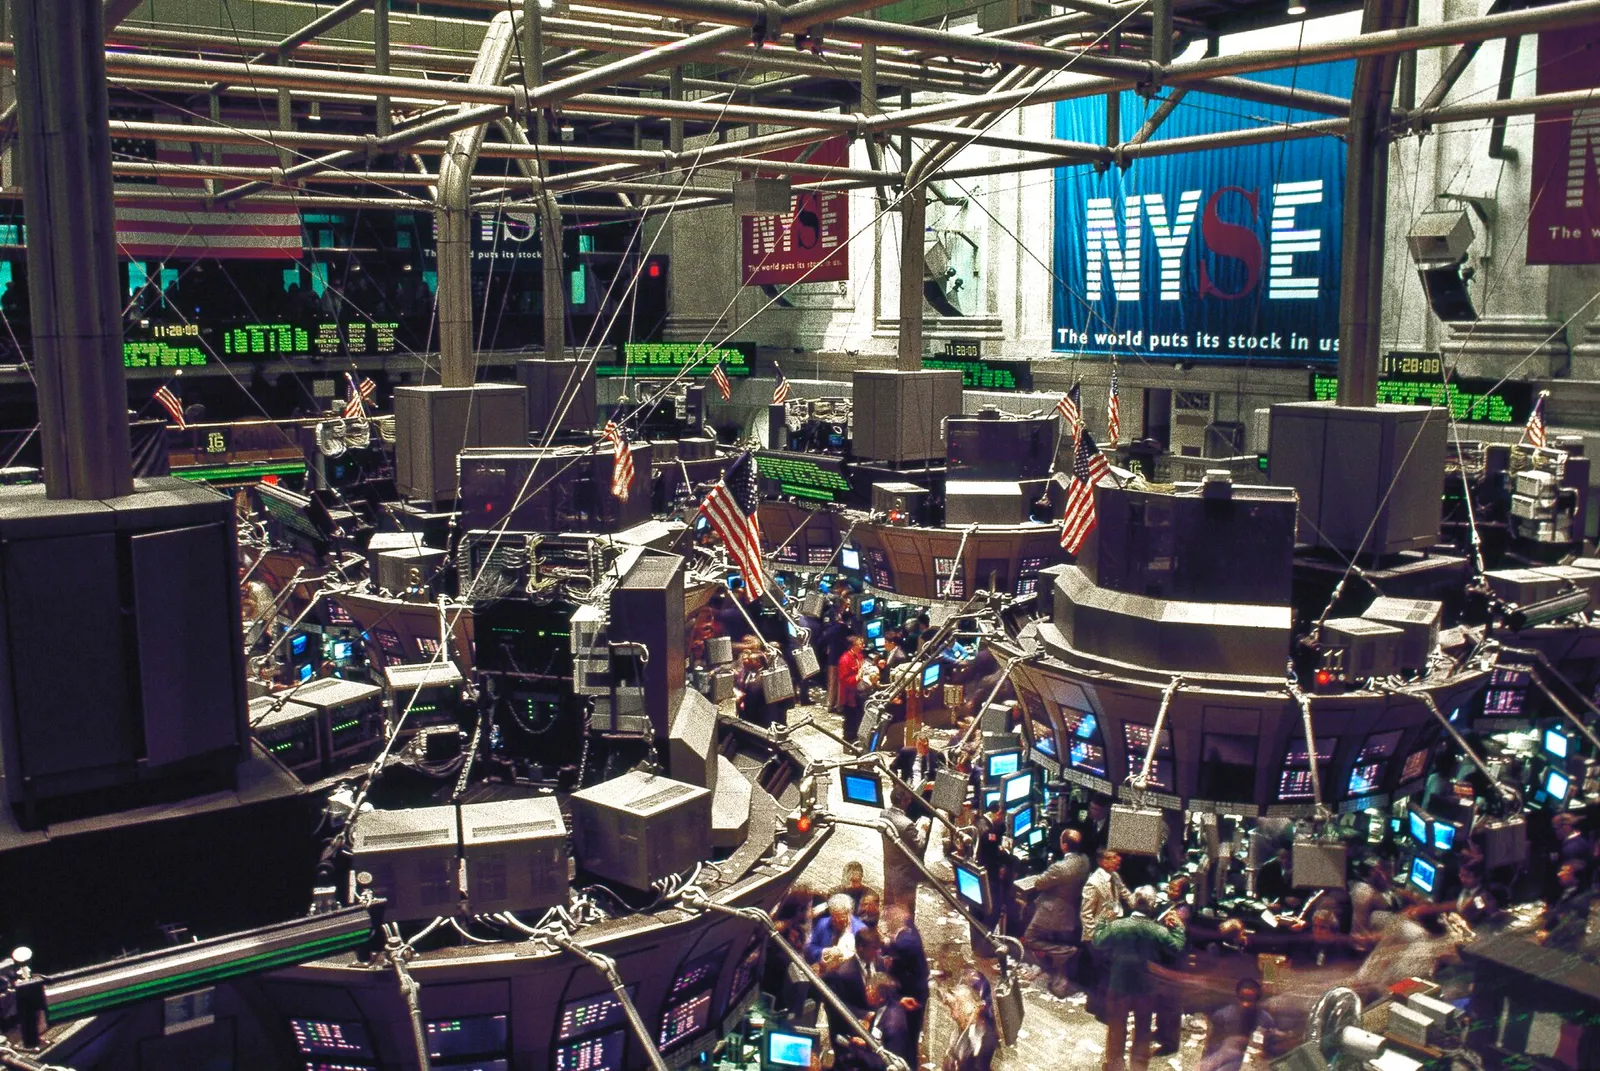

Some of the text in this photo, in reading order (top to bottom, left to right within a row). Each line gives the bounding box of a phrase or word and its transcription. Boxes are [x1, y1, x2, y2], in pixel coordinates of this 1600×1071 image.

[1550, 225, 1582, 239] The
[1086, 179, 1323, 301] NYSE
[478, 250, 498, 259] puts
[502, 250, 514, 258] its
[518, 250, 542, 258] stock
[1057, 328, 1088, 344] The
[1094, 330, 1142, 346] world
[1149, 333, 1189, 351] puts
[1196, 331, 1220, 349] its
[1228, 333, 1281, 350] stock
[1291, 332, 1309, 350] in
[208, 436, 224, 448] 16
